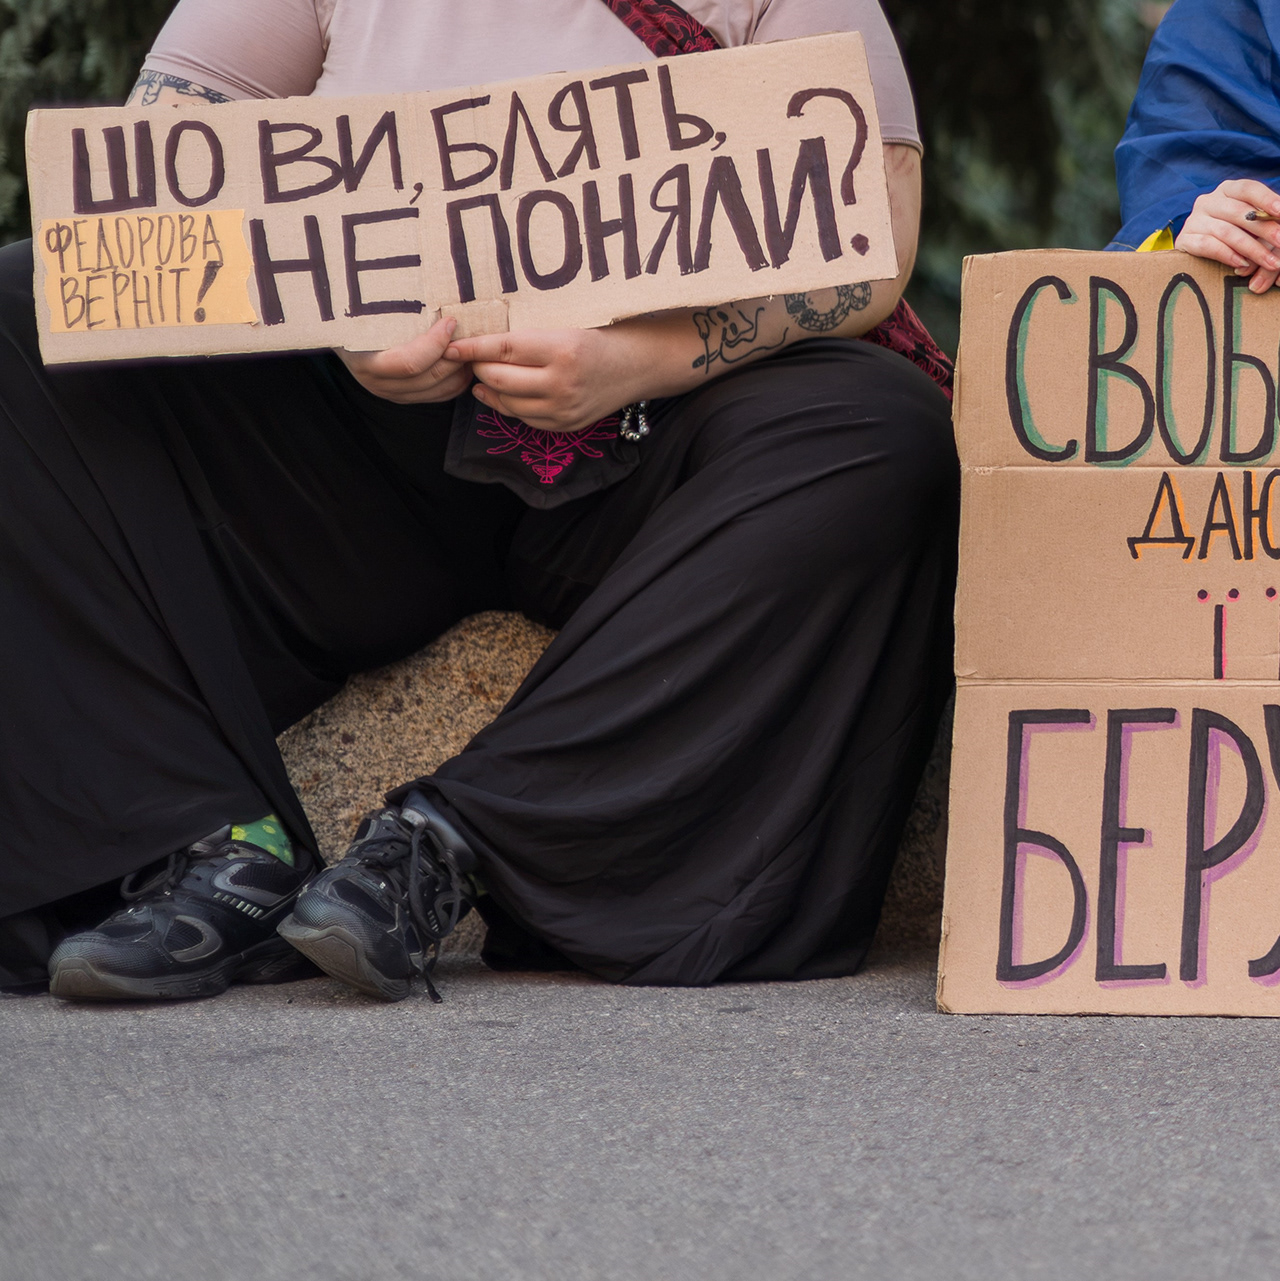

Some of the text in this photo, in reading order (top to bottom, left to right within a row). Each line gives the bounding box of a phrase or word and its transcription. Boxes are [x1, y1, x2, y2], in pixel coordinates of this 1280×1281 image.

[72, 65, 728, 214] ШО ВИ, БЛЯТЬ,
[249, 88, 871, 326] НЕ ПОНЯЛИ?
[46, 214, 223, 273] ФЕДОРОВА
